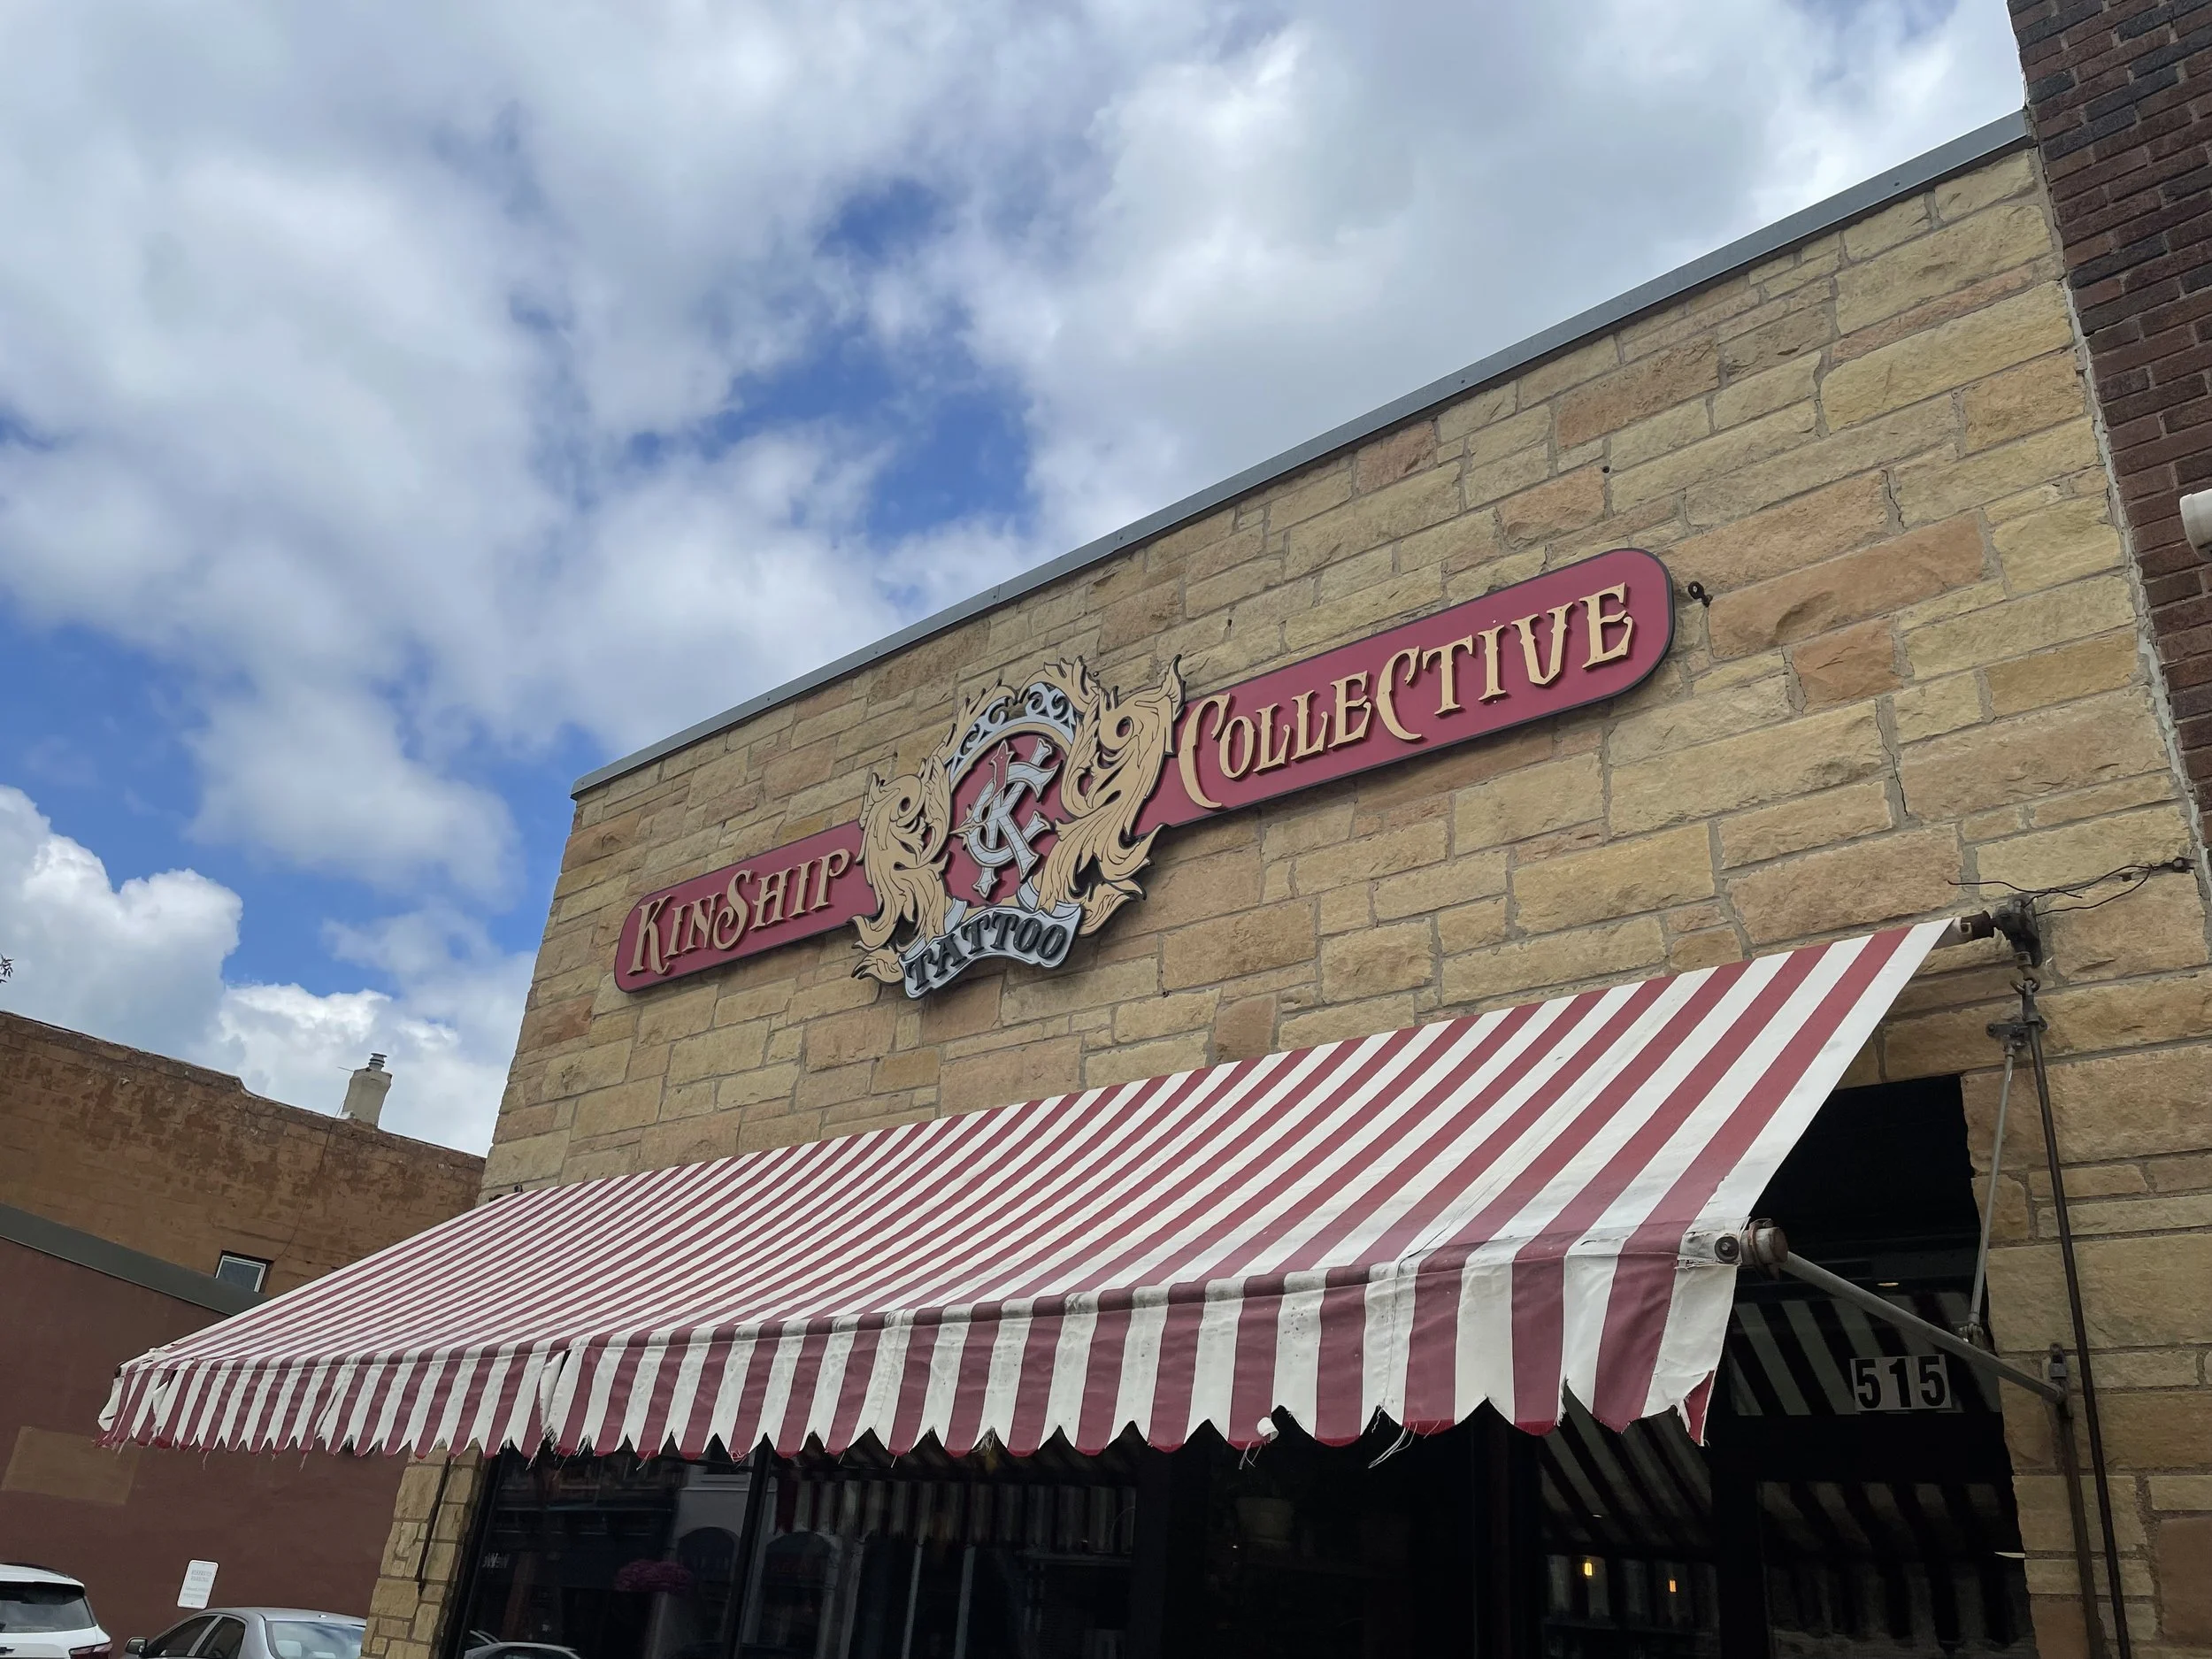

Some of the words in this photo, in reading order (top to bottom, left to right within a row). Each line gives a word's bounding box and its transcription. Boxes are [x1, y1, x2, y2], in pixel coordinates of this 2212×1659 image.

[626, 848, 852, 975] KINSHIP
[1179, 582, 1636, 809] COLLECTIVE
[905, 911, 1067, 991] TATTOO
[1855, 1356, 1946, 1409] 515
